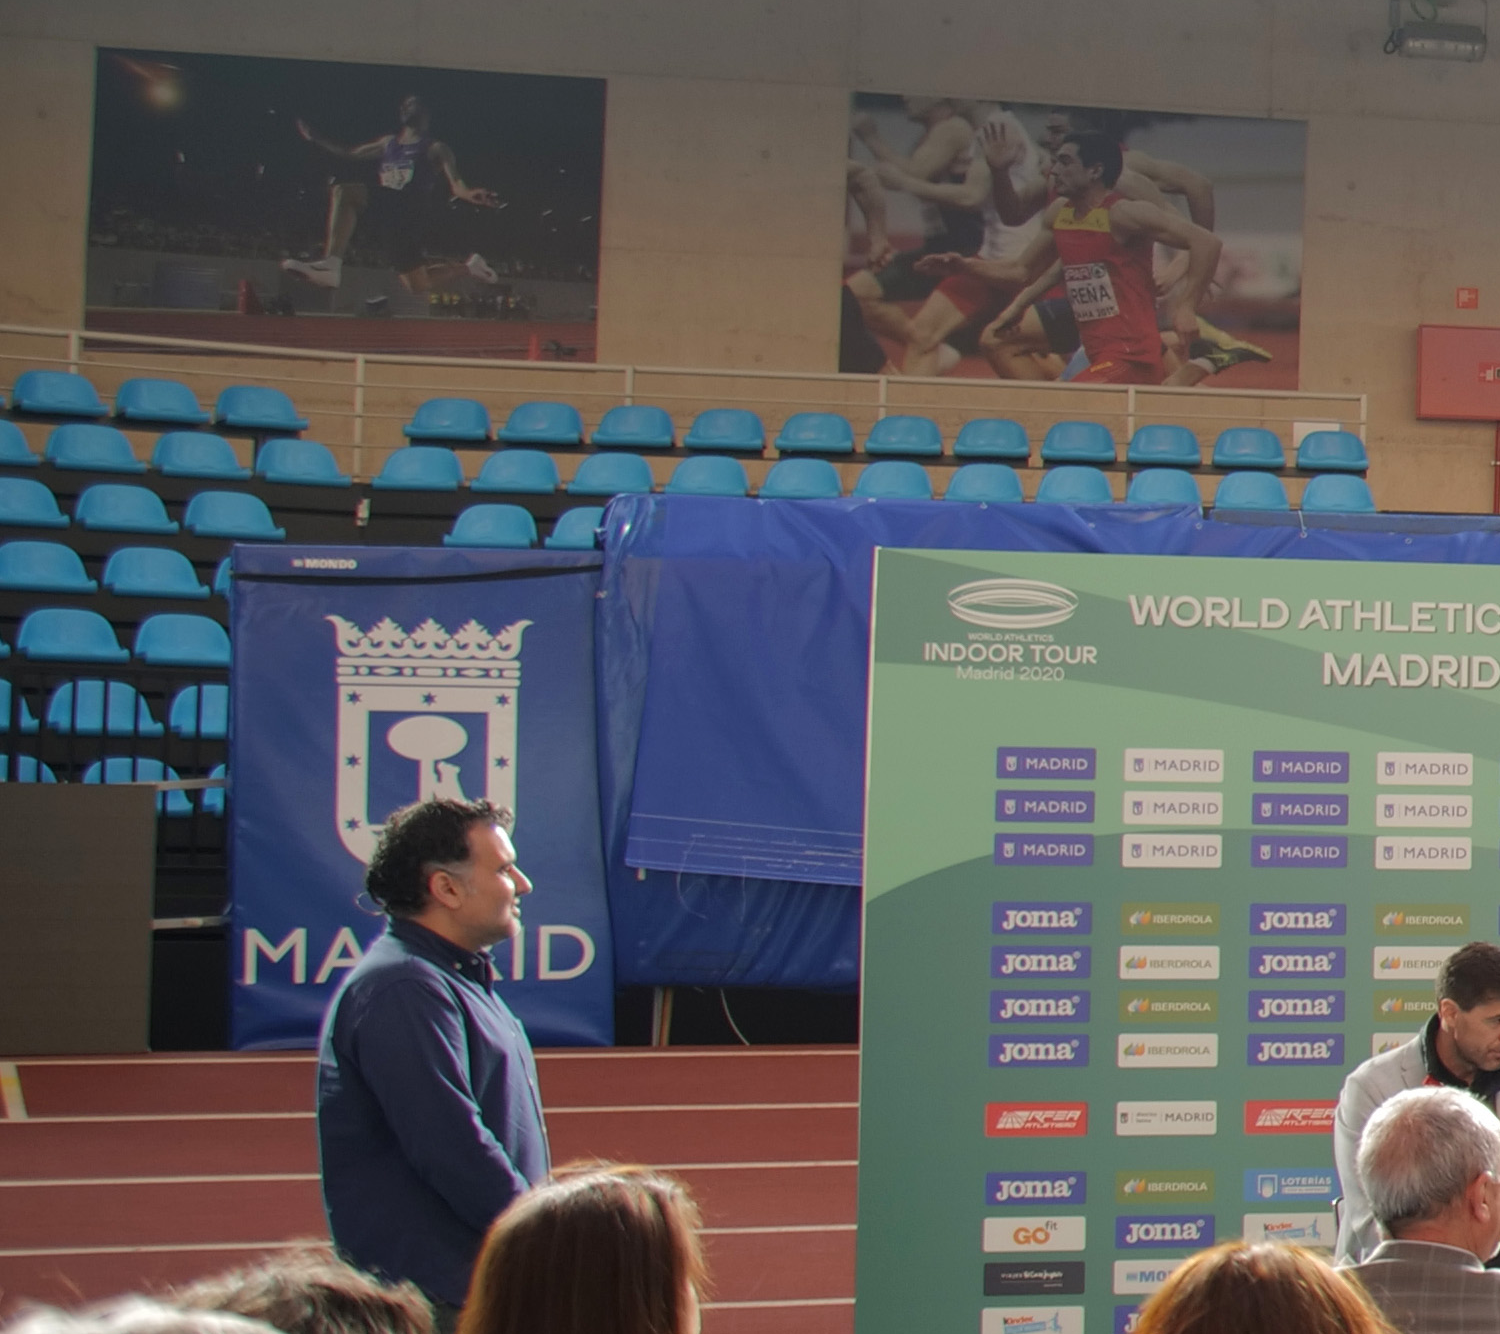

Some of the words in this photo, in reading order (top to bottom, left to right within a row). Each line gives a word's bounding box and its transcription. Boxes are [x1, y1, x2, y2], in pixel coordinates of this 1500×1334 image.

[1130, 595, 1291, 630] WORLD
[968, 633, 1002, 642] WORLD
[1004, 633, 1054, 642] ATHLETICS
[923, 643, 1024, 663] INDOOR
[1030, 645, 1097, 665] TOUR
[956, 665, 1014, 680] Madrid
[1019, 666, 1065, 681] 2020
[1026, 757, 1088, 771] MADRID
[1154, 759, 1219, 772] MADRID
[1281, 760, 1342, 775] MADRID
[1404, 762, 1469, 776] MADRID
[1023, 843, 1086, 858] MADRID
[1279, 846, 1340, 860] MADRID
[1003, 910, 1078, 930] Joma
[1152, 913, 1213, 925] IBERDROLA
[1260, 910, 1333, 930] Joma
[1405, 914, 1464, 926] IBERDROLA
[242, 924, 595, 985] MAID
[1030, 1110, 1082, 1121] RFEA
[1165, 1112, 1214, 1122] MADRID
[996, 1180, 1072, 1201] Joma
[1148, 1181, 1208, 1192] IBERDROLA
[1013, 1227, 1050, 1244] GO
[1045, 1220, 1058, 1231] fit
[1126, 1223, 1199, 1244] Joma
